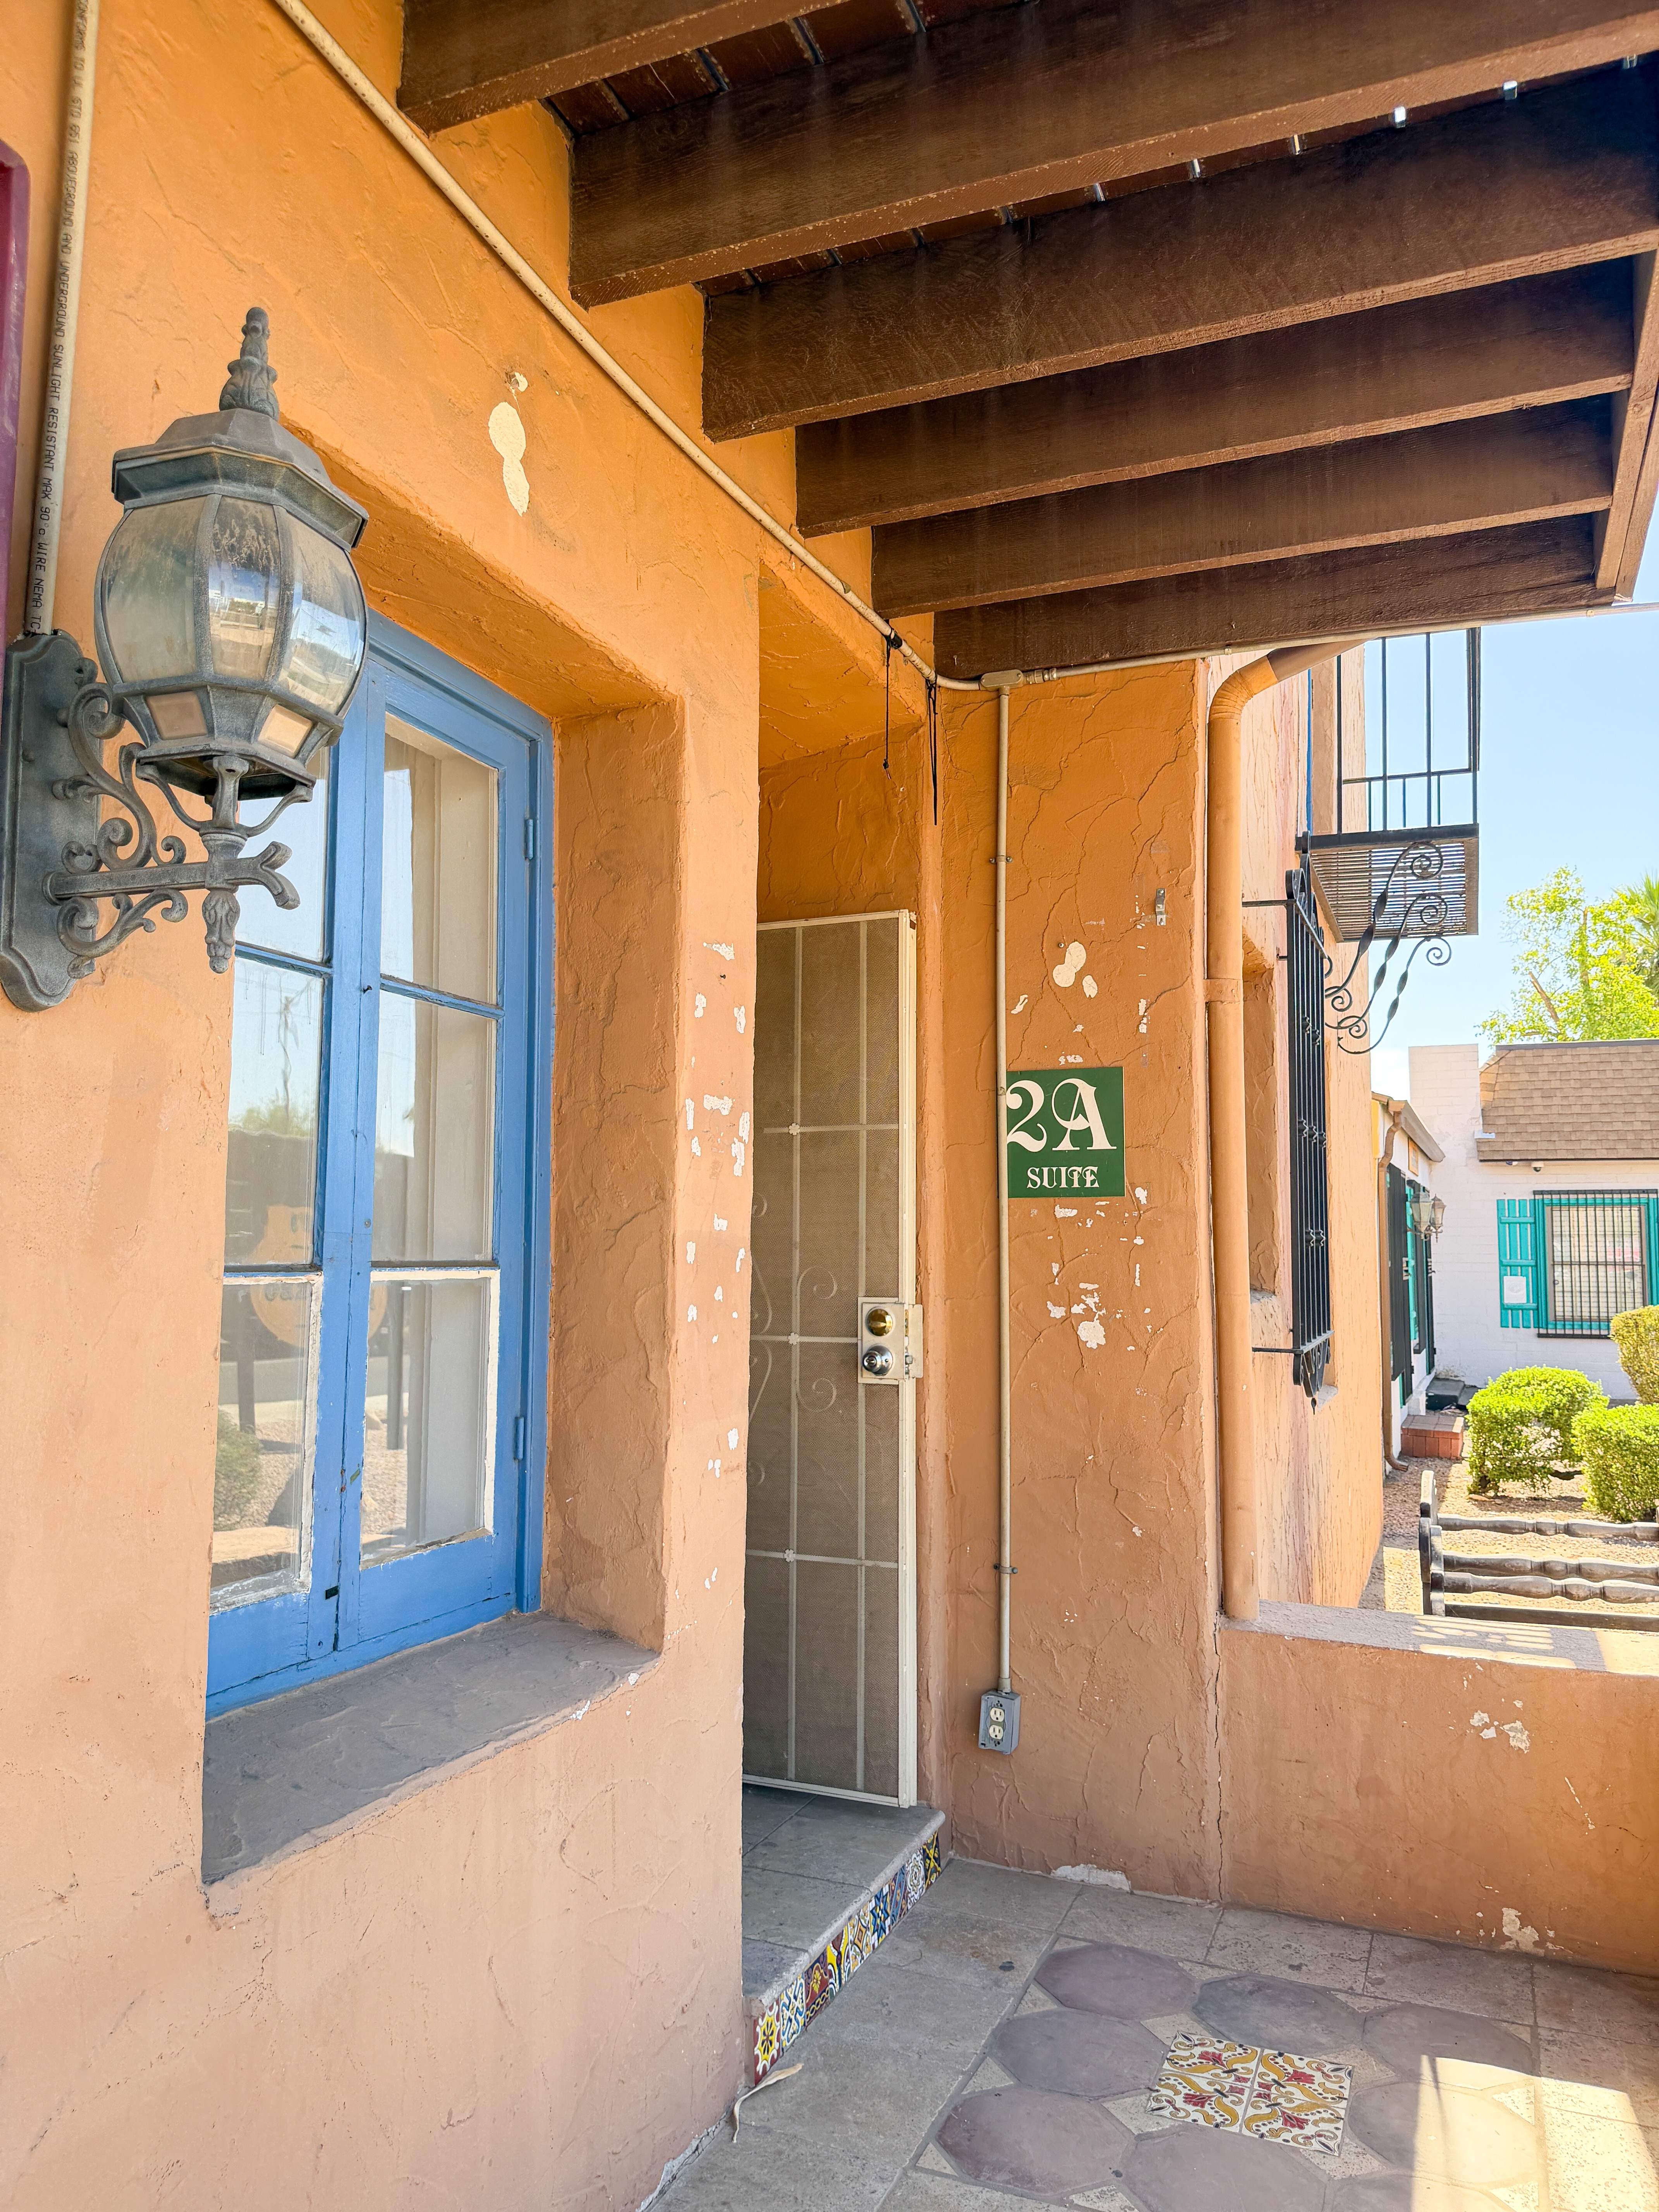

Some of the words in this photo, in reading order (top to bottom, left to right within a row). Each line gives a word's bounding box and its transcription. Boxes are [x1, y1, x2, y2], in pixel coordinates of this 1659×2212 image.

[69, 96, 82, 118] STD
[68, 123, 81, 144] 651
[63, 150, 79, 227] ABOVEGROUND
[61, 233, 73, 254] AND
[55, 261, 70, 337] UNDERGROUND
[50, 344, 64, 401] SUNLIGHT
[45, 407, 59, 471] RESISTANT
[41, 477, 52, 500] MAX
[35, 542, 48, 572] WIRE
[32, 578, 44, 608] NEMA
[1006, 1078, 1117, 1152] 2A
[1027, 1166, 1099, 1189] SUITE
